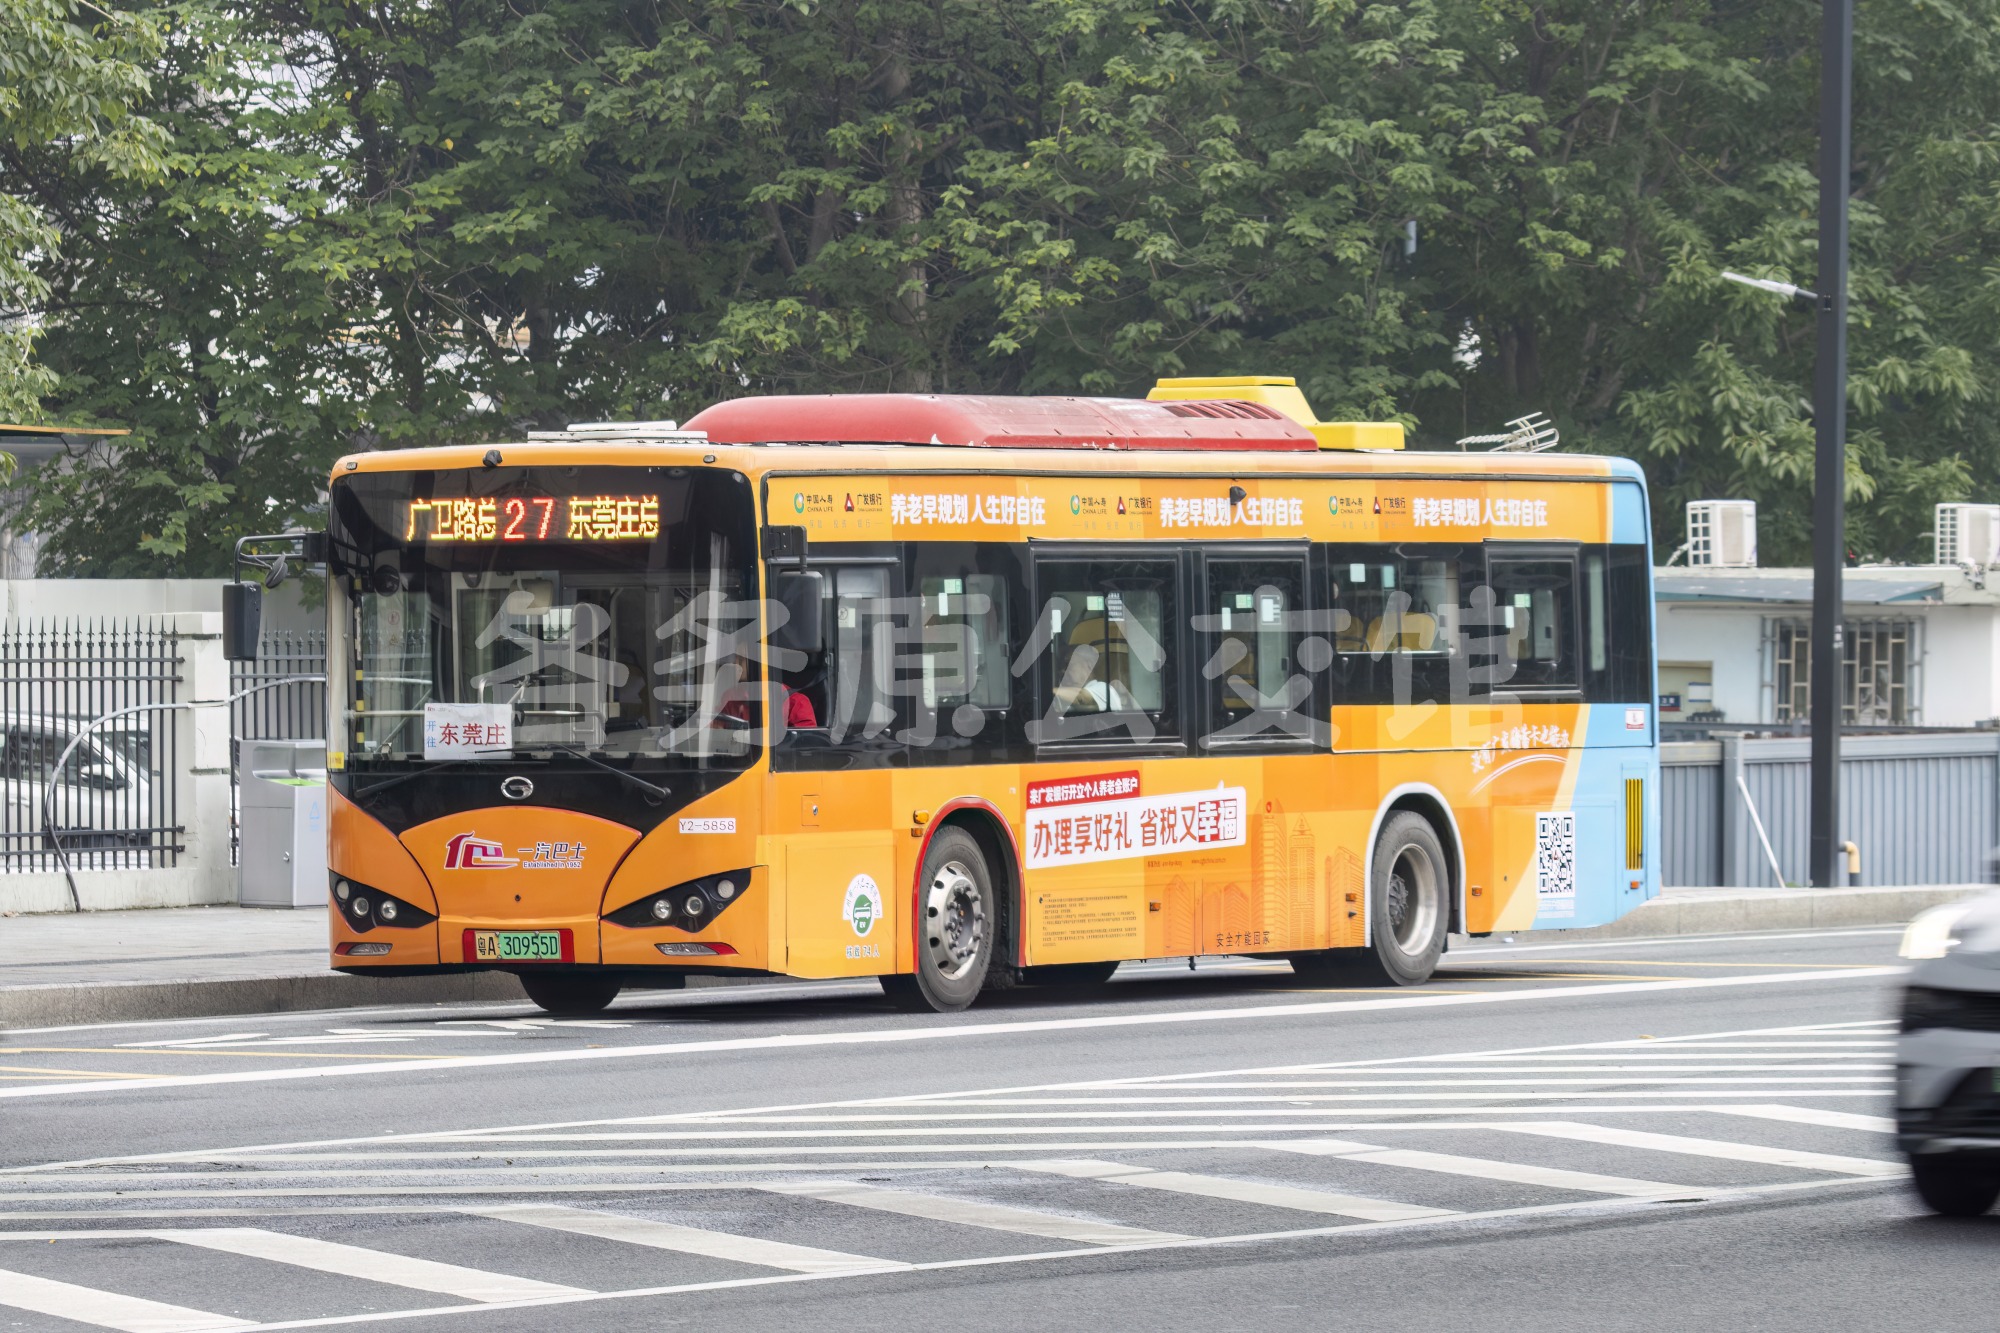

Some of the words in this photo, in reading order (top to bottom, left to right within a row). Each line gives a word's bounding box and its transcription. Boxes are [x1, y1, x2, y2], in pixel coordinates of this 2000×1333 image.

[856, 493, 882, 506] 广发银行
[406, 497, 497, 542] 广卫路总
[503, 498, 554, 540] 27
[567, 494, 660, 541] 东莞庄总
[427, 720, 436, 748] 开往
[439, 722, 507, 746] 东莞庄
[680, 820, 735, 831] Y2-5858
[1033, 811, 1133, 860] 办理享好礼
[1139, 798, 1238, 848] 省税又幸福
[518, 842, 586, 860] 一汽巴士
